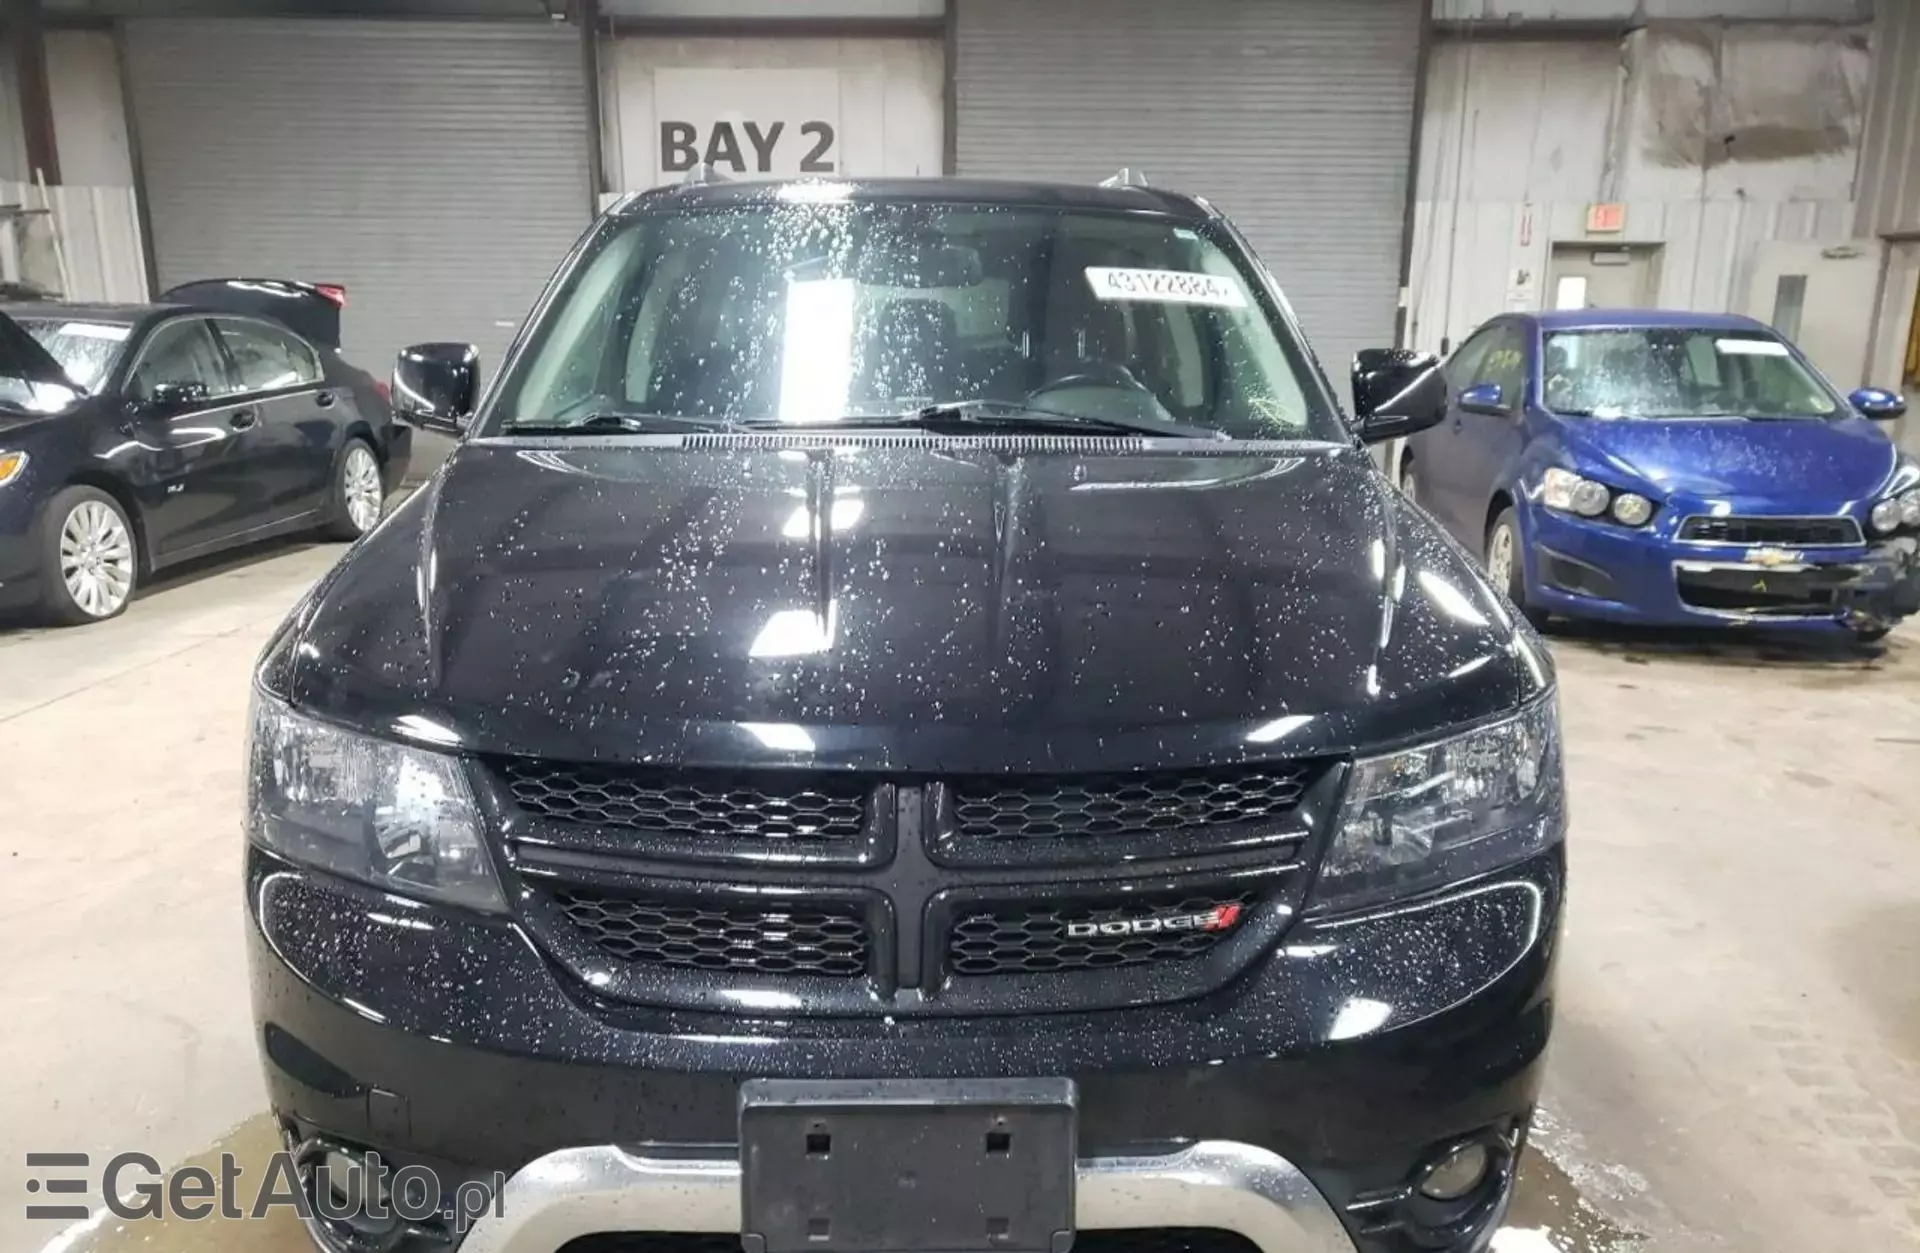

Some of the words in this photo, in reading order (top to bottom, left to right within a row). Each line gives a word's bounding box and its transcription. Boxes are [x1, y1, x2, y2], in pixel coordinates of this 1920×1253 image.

[660, 121, 785, 172] BAY
[800, 121, 835, 172] 2
[1068, 911, 1220, 937] DODGE
